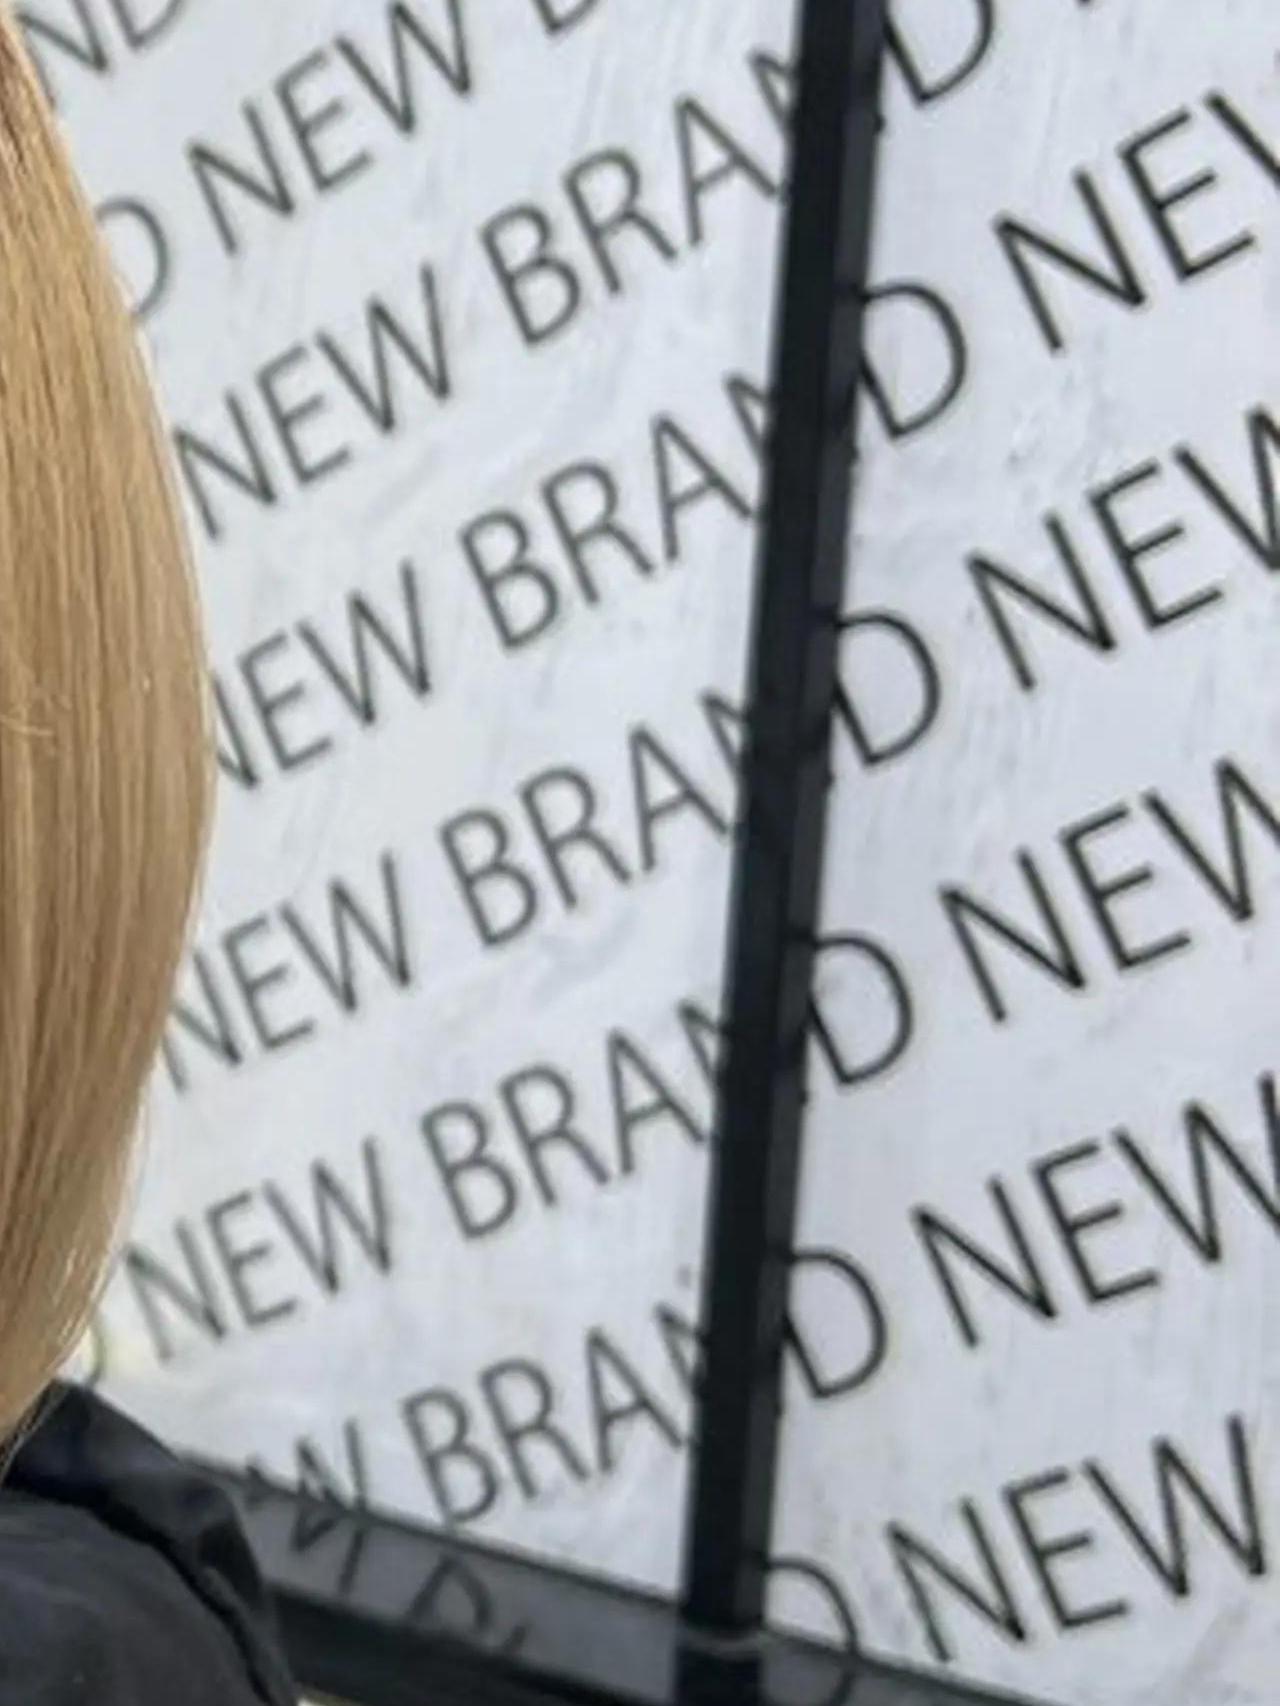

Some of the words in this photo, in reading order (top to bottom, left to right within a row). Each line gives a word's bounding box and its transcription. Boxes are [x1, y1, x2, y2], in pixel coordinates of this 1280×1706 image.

[171, 259, 452, 543] NEW
[122, 1133, 395, 1363] NEW
[935, 753, 1280, 1025] NEW
[160, 846, 416, 1095] NEW
[908, 1068, 1280, 1353] NEW
[883, 1411, 1268, 1665] NEW
